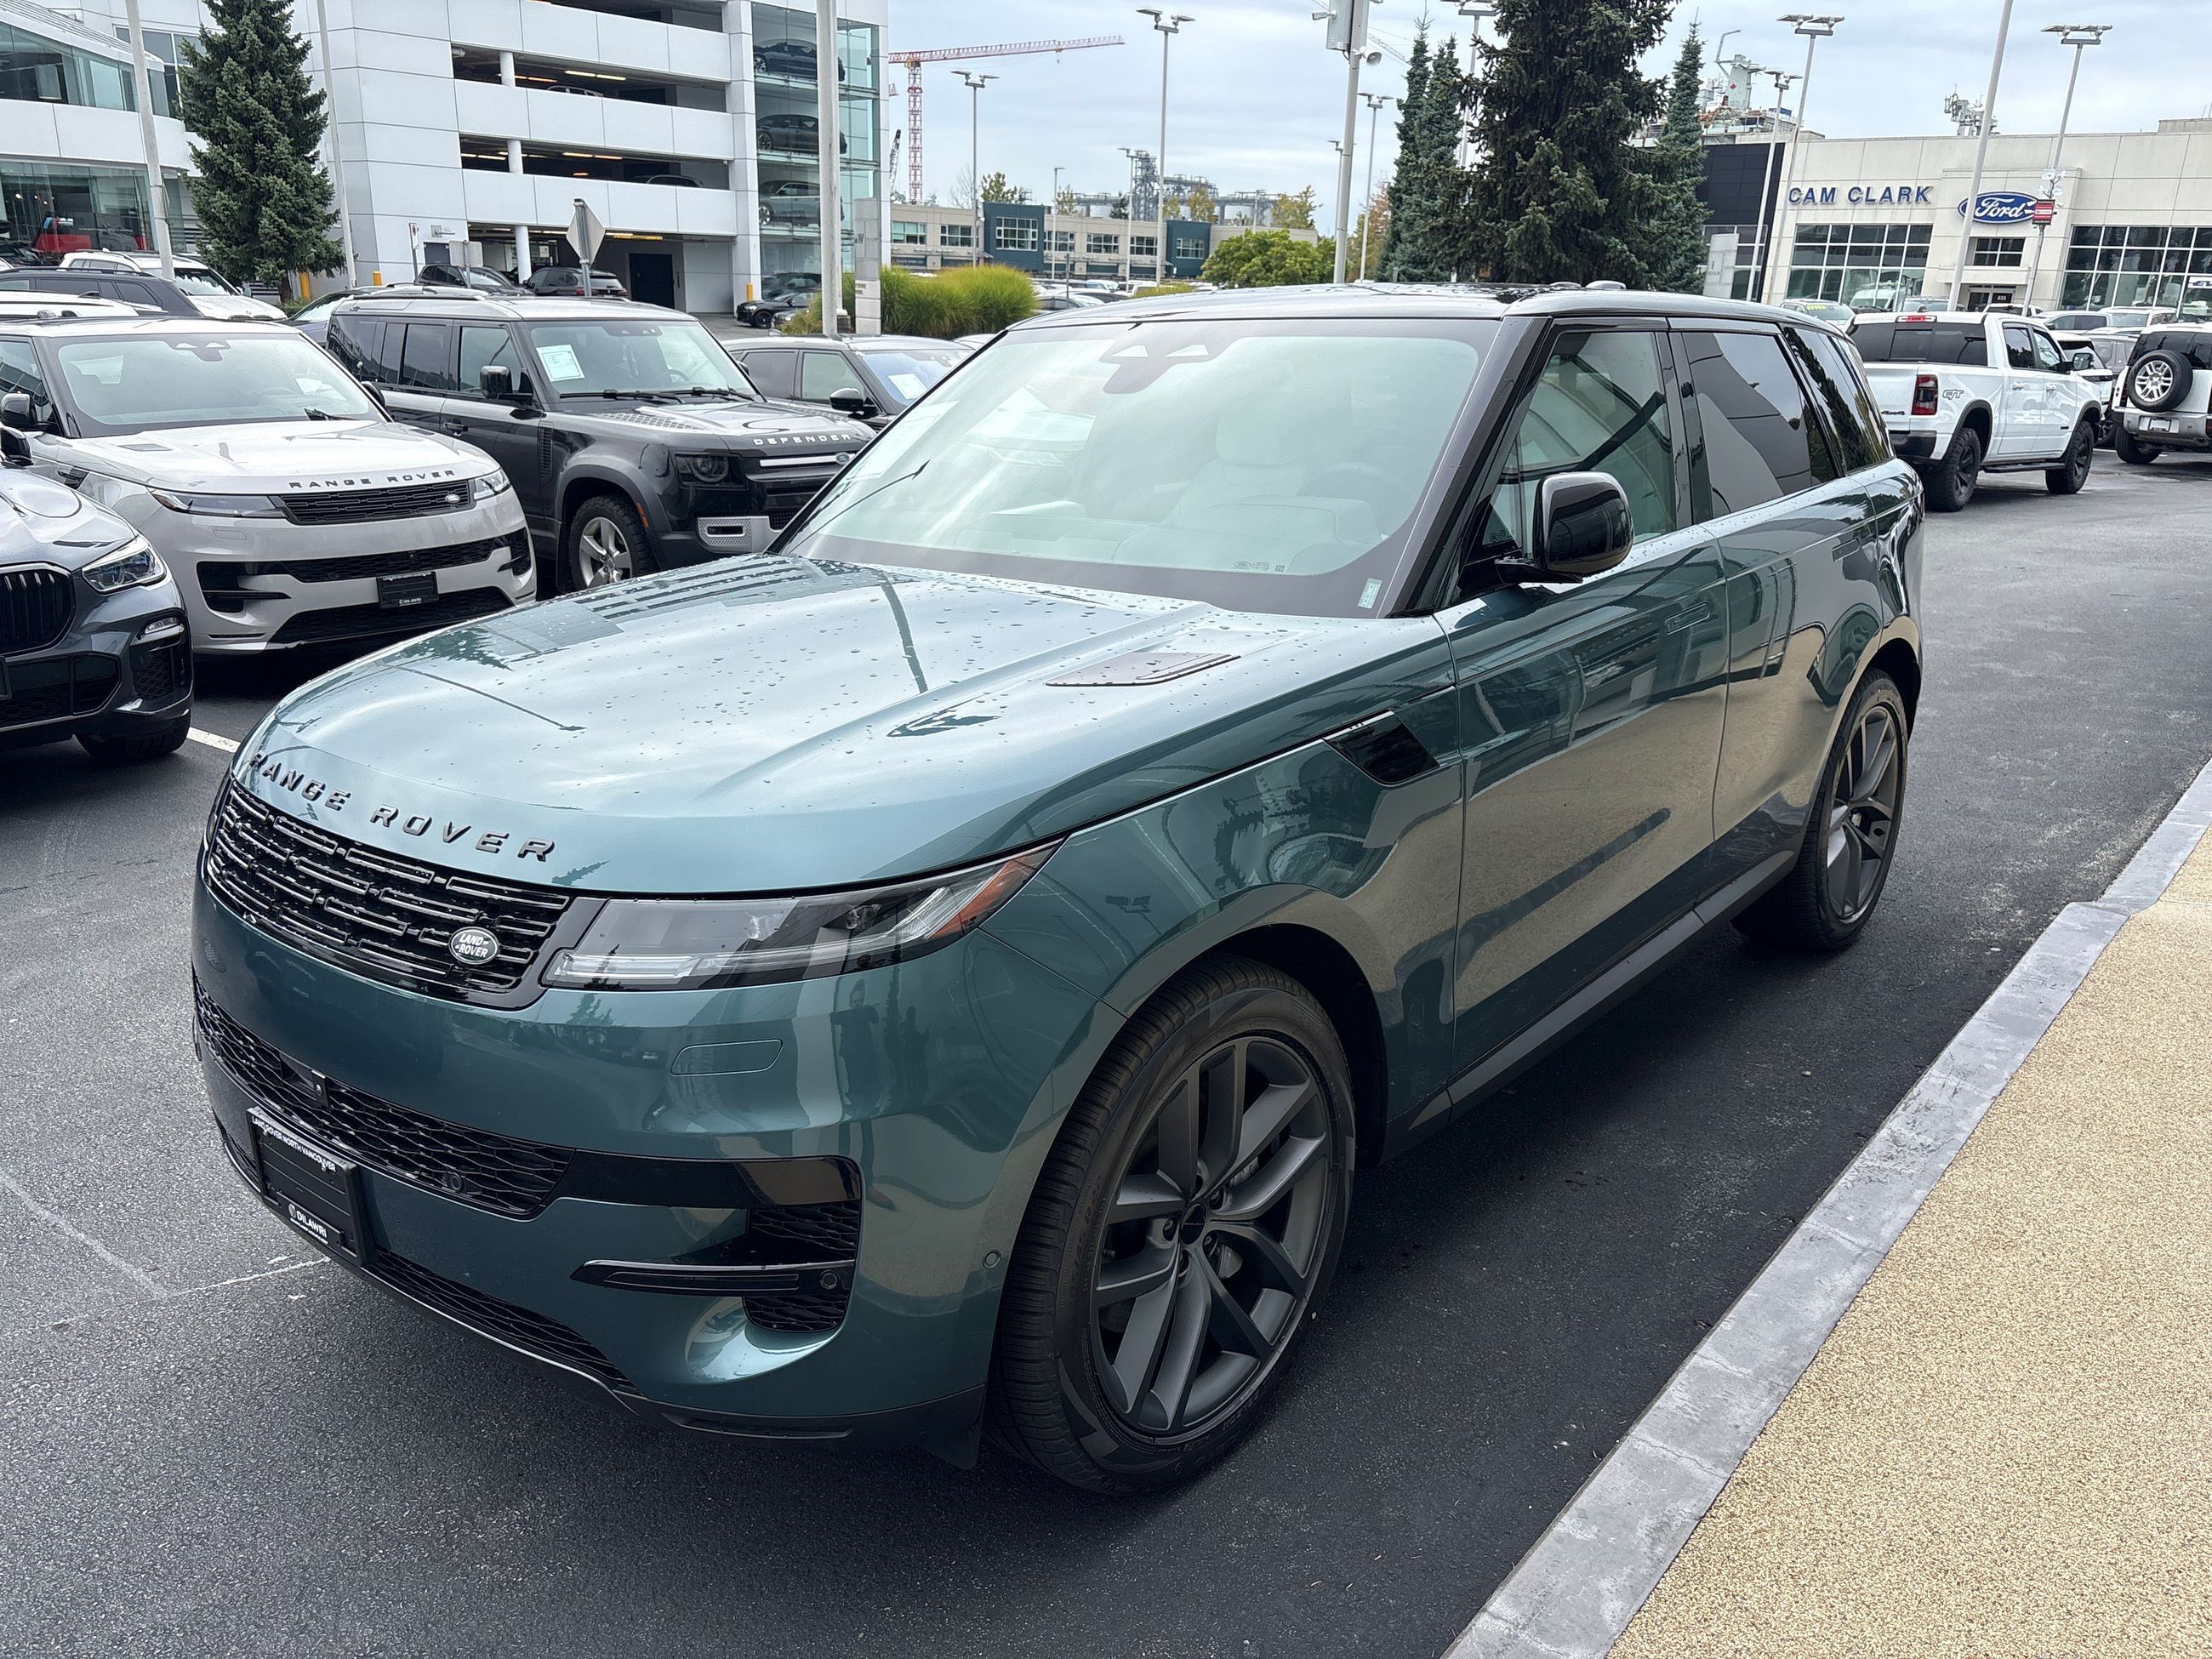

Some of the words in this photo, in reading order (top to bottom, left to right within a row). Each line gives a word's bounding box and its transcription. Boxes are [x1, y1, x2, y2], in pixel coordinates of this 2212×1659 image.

[1788, 187, 1837, 205] CAM
[1847, 185, 1934, 205] CLARK
[1974, 196, 2037, 219] Ford
[752, 433, 852, 447] DEFENDER
[288, 477, 372, 489] RANGE
[386, 469, 456, 483] ROVER
[249, 750, 352, 812] RANGE
[369, 803, 556, 863] ROVER
[459, 933, 484, 946] LAND
[458, 944, 489, 958] ROVER
[282, 1135, 302, 1152] NORTH
[296, 1210, 328, 1239] DILAWRI
